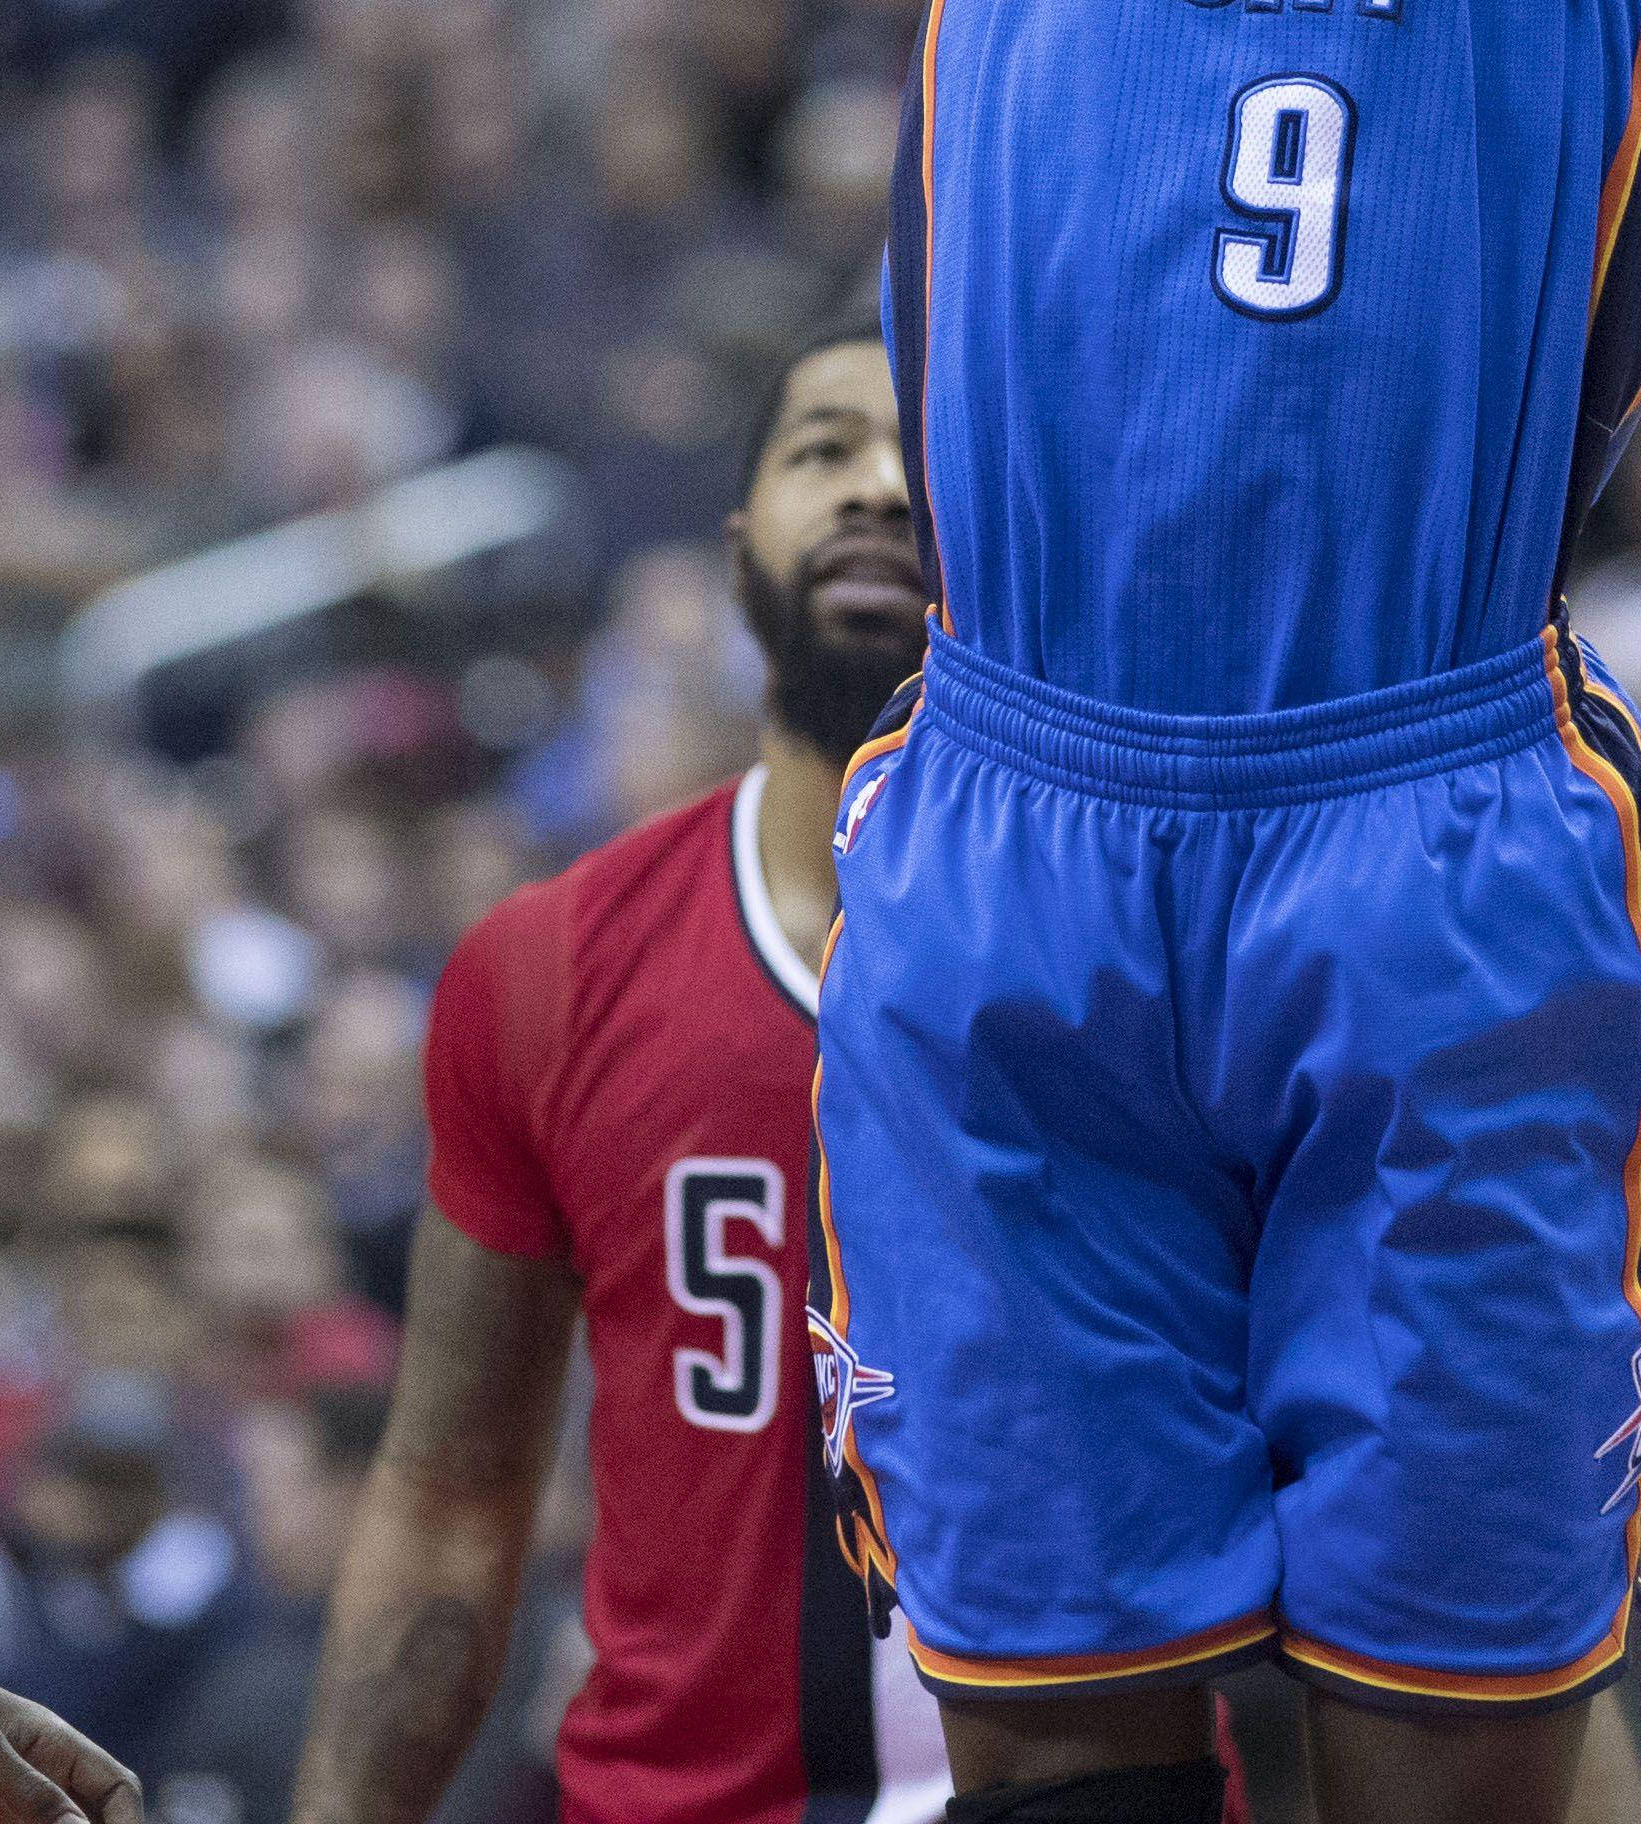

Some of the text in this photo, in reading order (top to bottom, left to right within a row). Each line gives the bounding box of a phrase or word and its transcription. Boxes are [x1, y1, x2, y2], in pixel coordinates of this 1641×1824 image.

[1210, 72, 1357, 323] 9
[664, 1155, 786, 1433] 5
[813, 1353, 836, 1405] KC
